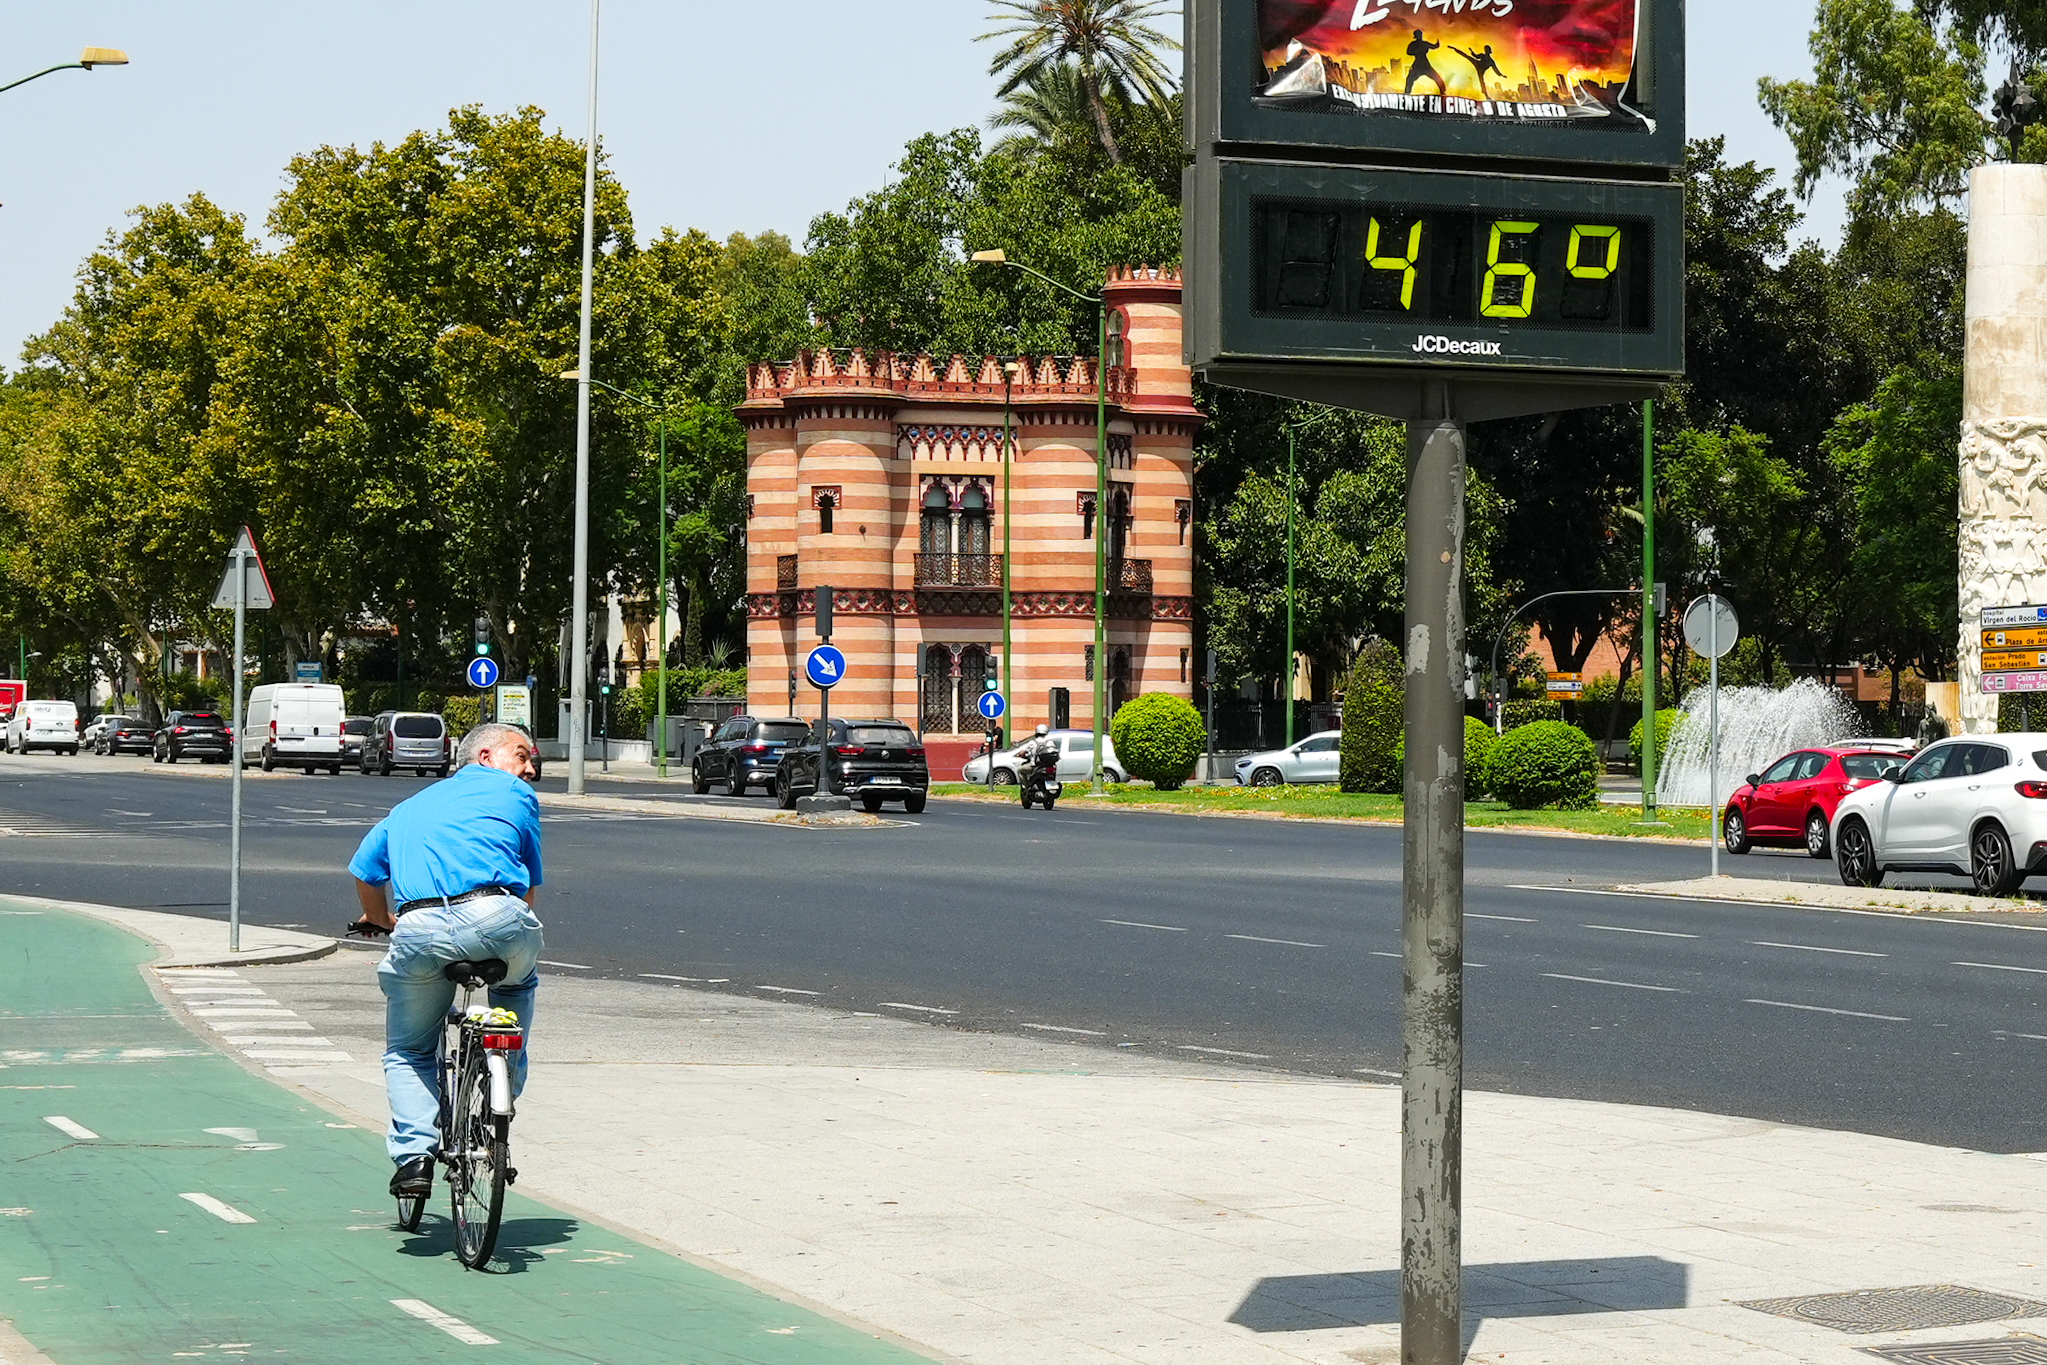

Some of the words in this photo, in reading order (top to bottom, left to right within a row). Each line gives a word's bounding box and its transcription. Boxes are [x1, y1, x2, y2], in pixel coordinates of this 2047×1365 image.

[1428, 95, 1443, 114] EN
[1445, 96, 1478, 117] CINES
[1481, 101, 1495, 116] 8
[1495, 101, 1515, 117] DE
[1516, 103, 1568, 117] AGOSTO
[1411, 334, 1502, 355] JCDecaux
[1983, 616, 2004, 625] Virgen
[2005, 615, 2017, 623] del
[2026, 637, 2035, 645] de
